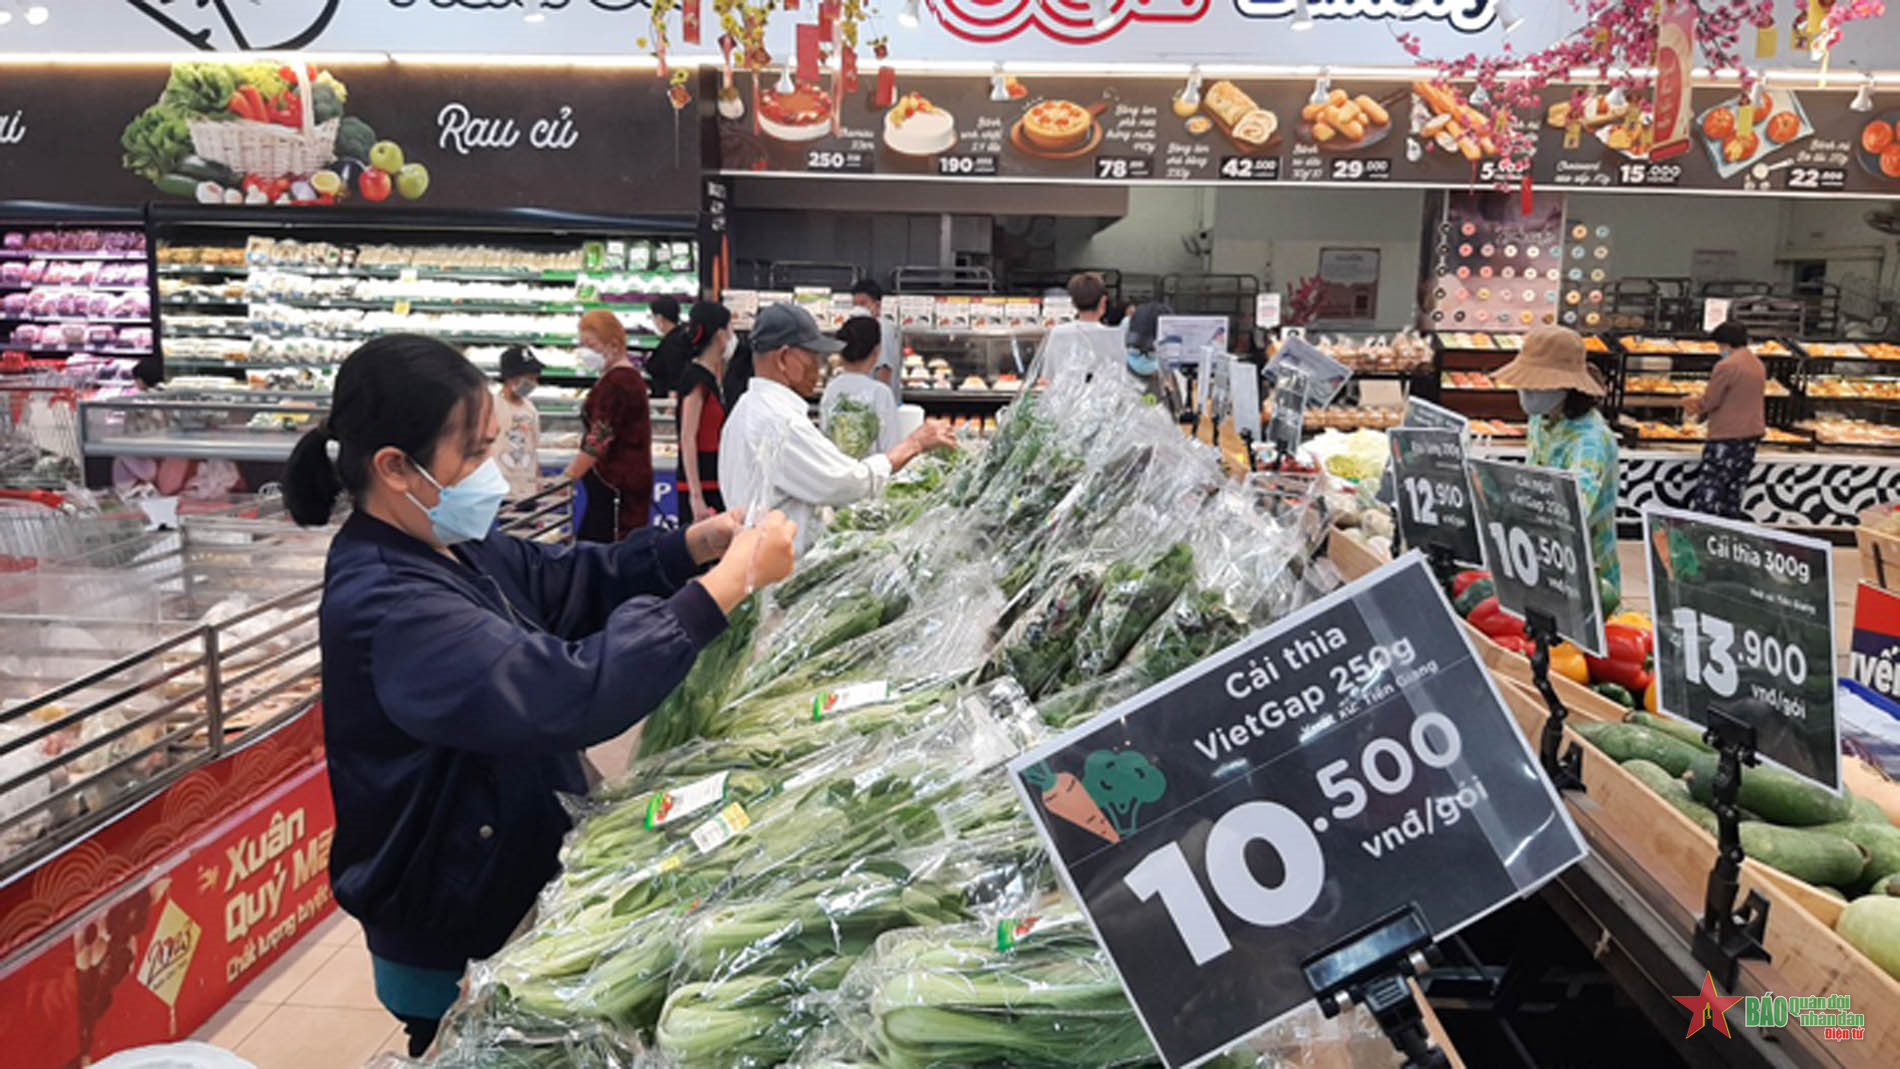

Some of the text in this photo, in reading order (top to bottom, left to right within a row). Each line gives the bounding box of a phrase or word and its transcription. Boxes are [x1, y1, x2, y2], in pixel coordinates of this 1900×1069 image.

[437, 102, 579, 154] Rau củ
[1764, 550, 1811, 585] 300g
[1225, 655, 1281, 699] Cải
[1672, 606, 1807, 698] 13.900
[1193, 637, 1417, 761] VietGap 250g
[224, 808, 304, 893] Xuân
[1122, 711, 1463, 966] 10.500
[1360, 774, 1489, 859] vnđ/gói
[225, 860, 287, 943] Quý
